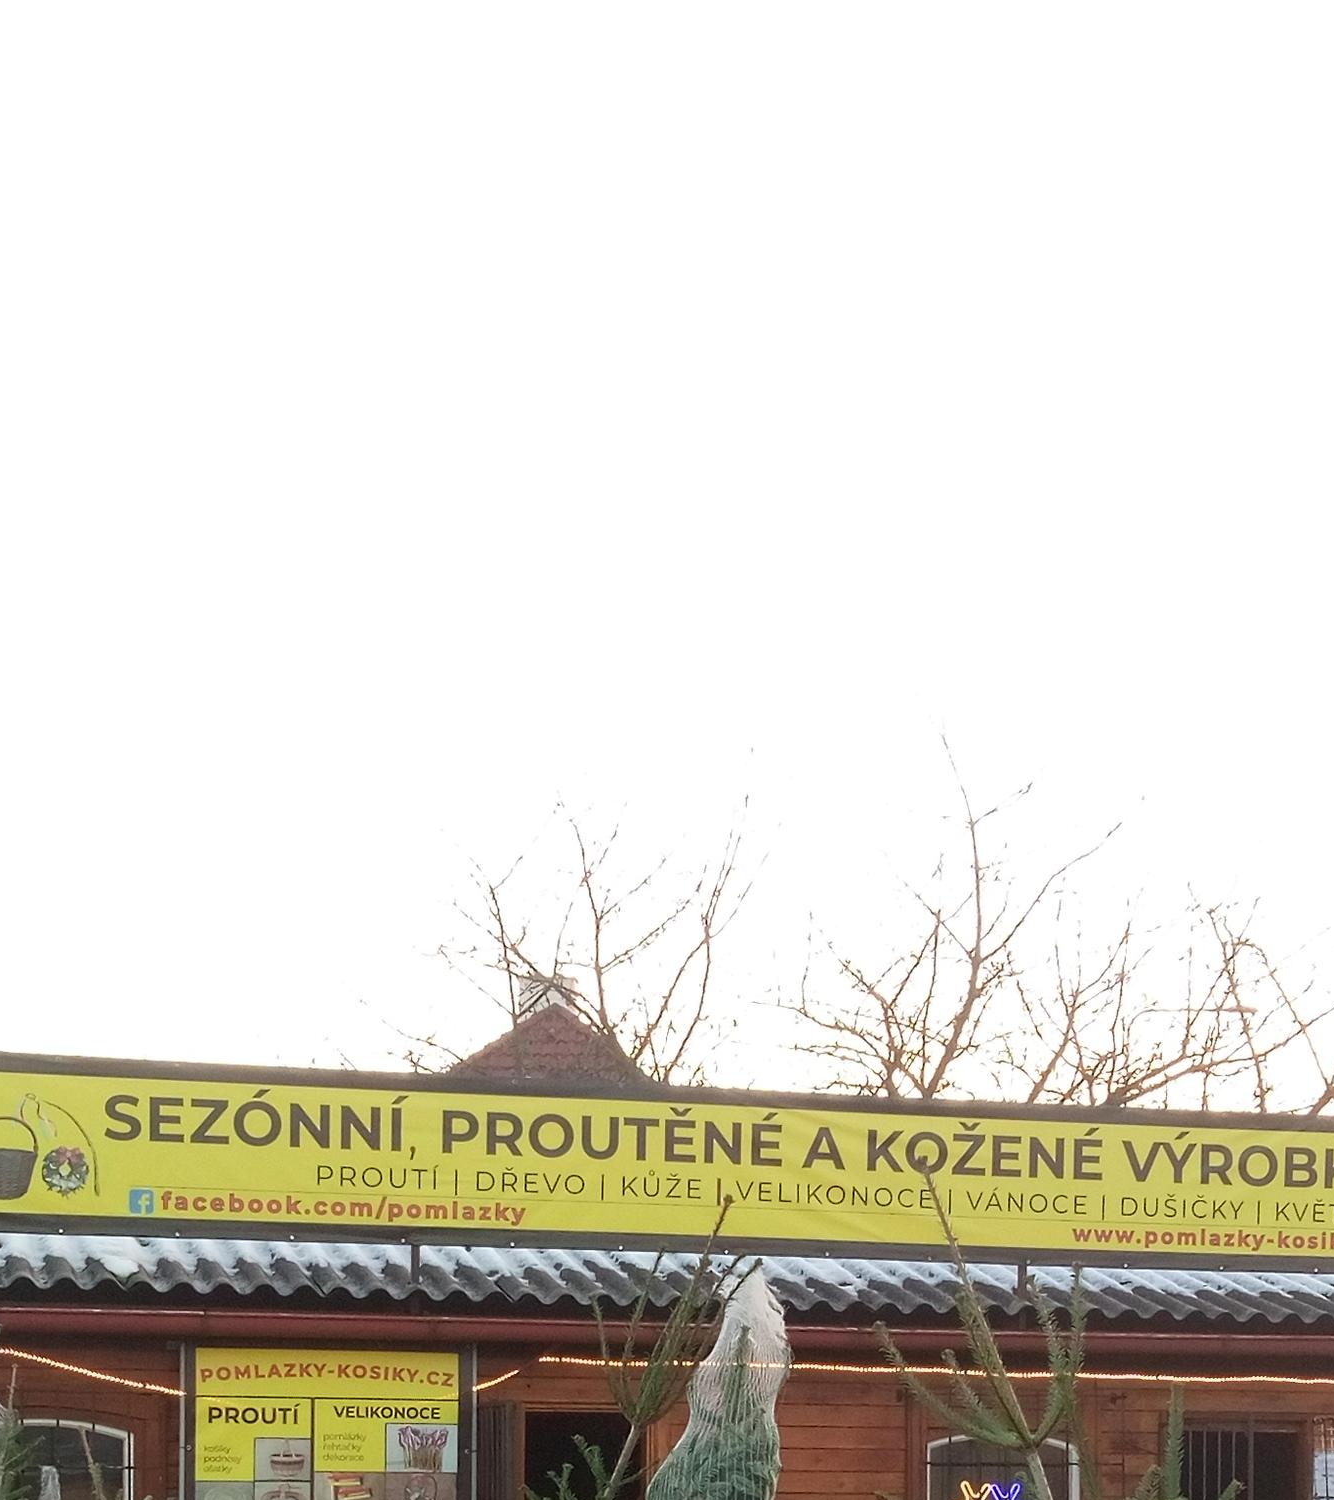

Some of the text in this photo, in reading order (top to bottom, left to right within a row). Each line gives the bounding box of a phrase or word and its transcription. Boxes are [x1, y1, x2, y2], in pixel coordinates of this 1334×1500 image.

[104, 1089, 416, 1160] SEZÓNNÍ,
[442, 1107, 783, 1168] PROUTĚNÉ
[802, 1127, 845, 1170] A
[867, 1121, 1103, 1180] KOŽENÉ
[161, 1190, 526, 1226] facebook.com/pomlazky
[316, 1165, 439, 1190] PROUTÍ
[475, 1168, 586, 1195] DŘEVO
[622, 1170, 702, 1200] KŮŽE
[736, 1180, 934, 1210] VELIKONOCE
[966, 1187, 1087, 1215] VÁNOCE
[1120, 1194, 1244, 1220] DUŠIČKY
[200, 1362, 455, 1388] POMLAZKY-KOSIKY.CZ
[207, 1404, 299, 1425] PROUTÍ
[334, 1405, 441, 1421] VELIKONOCE
